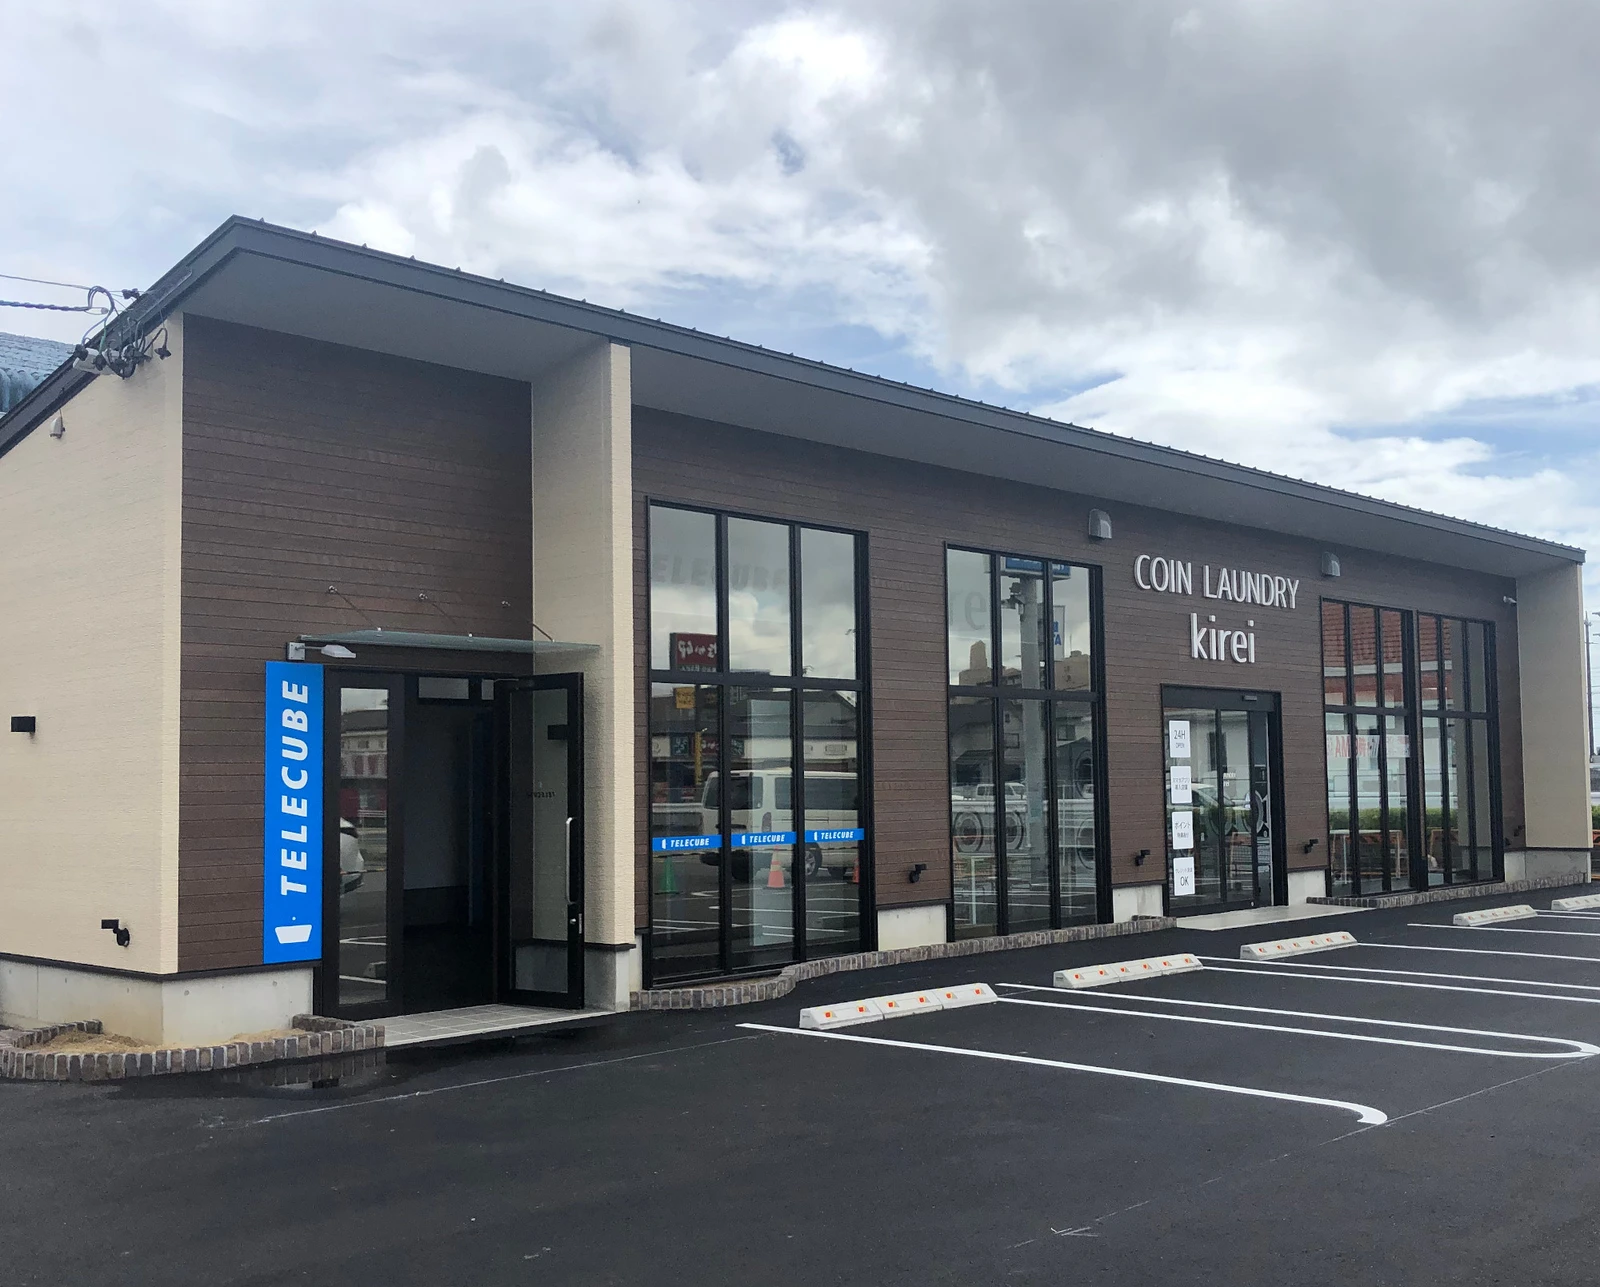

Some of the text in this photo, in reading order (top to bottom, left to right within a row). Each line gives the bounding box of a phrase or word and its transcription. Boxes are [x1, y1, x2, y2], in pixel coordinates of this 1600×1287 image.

[1134, 554, 1299, 609] COIN LAUNDRY
[1190, 612, 1255, 663] kirei
[1174, 729, 1186, 740] 24H
[281, 679, 308, 896] TELECUBE
[749, 834, 786, 843] TELECUBE
[821, 831, 854, 840] TELECUBE
[670, 837, 710, 848] TELECUBE
[1180, 876, 1189, 886] OK
